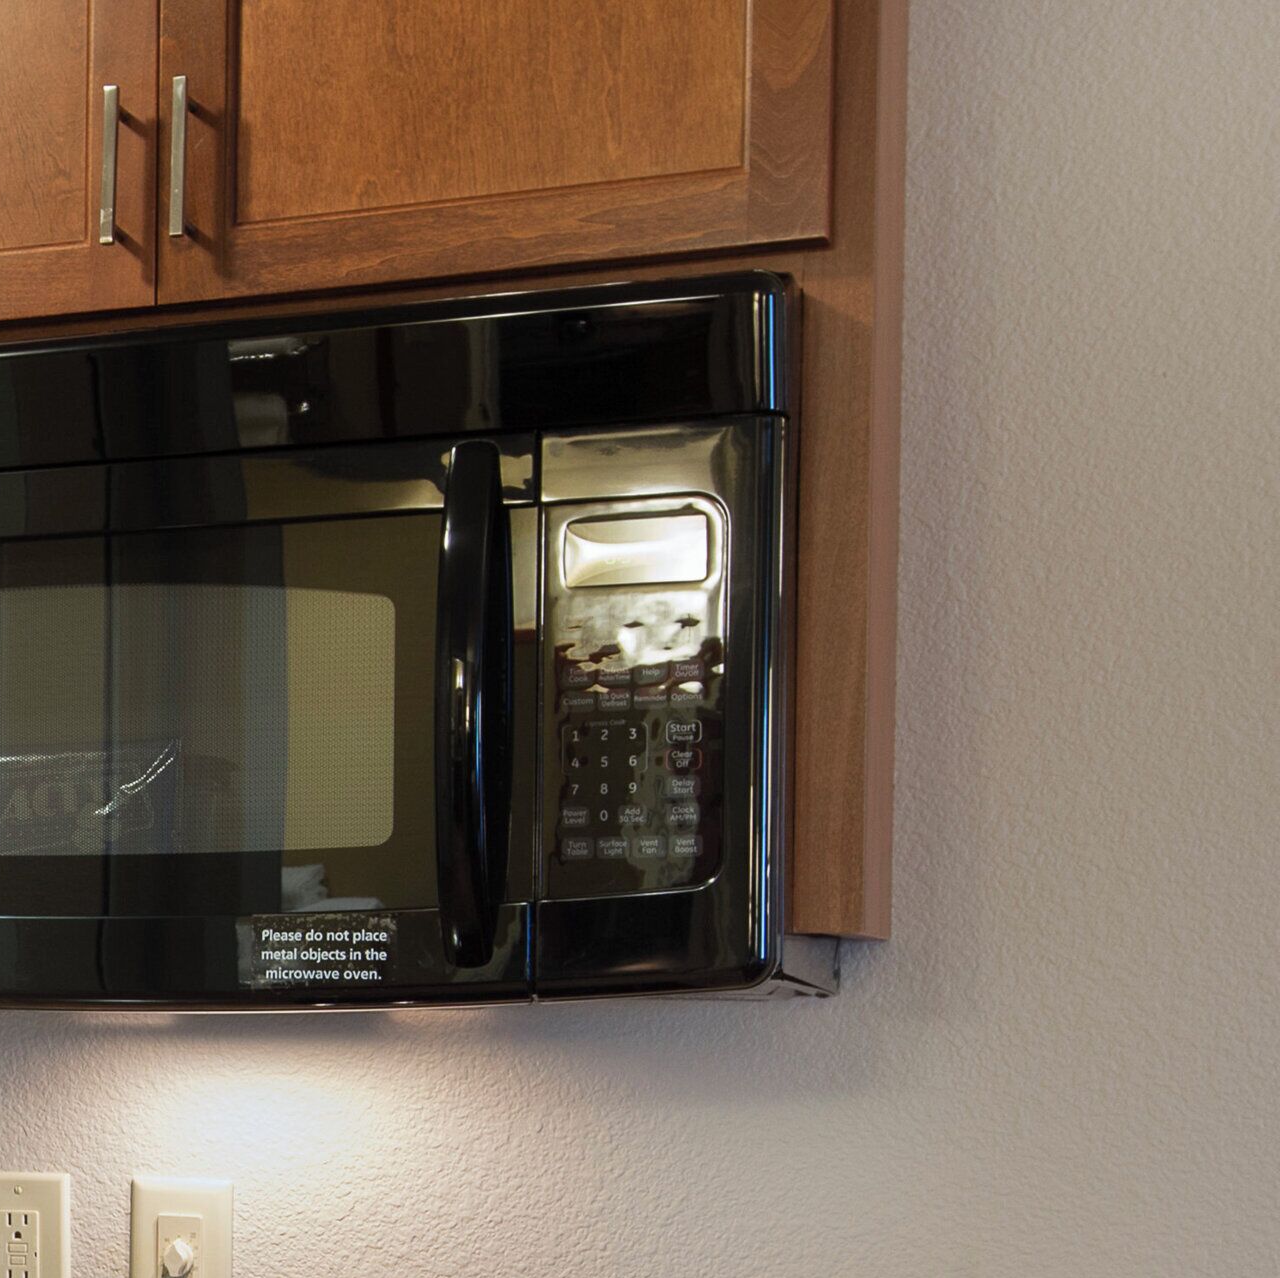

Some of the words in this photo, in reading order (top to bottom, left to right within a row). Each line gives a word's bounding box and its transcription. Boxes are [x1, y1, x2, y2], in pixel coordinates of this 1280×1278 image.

[676, 662, 699, 671] Timer
[642, 669, 661, 678] Help
[563, 697, 594, 706] Custom
[671, 692, 703, 702] Options
[670, 722, 697, 733] Start
[572, 729, 580, 742] 1
[600, 728, 609, 741] 2
[628, 727, 637, 740] 3
[671, 749, 693, 759] Clear
[571, 756, 580, 769] 4
[600, 755, 609, 768] 5
[628, 754, 637, 767] 6
[676, 758, 690, 768] Off
[628, 781, 637, 794] 9
[671, 778, 695, 788] Delay
[571, 783, 580, 796] 7
[600, 782, 609, 795] 8
[672, 785, 694, 795] Start
[624, 807, 641, 815] Add
[672, 806, 695, 814] Clock
[599, 809, 609, 822] 0
[599, 839, 628, 848] Surface
[640, 838, 659, 847] Vent
[676, 837, 695, 846] Vent
[642, 846, 657, 855] Fan
[261, 929, 302, 942] Please
[305, 929, 323, 942] do
[326, 931, 350, 942] not
[353, 929, 388, 945] place
[261, 948, 297, 961] metal
[300, 948, 347, 963] objects
[350, 948, 362, 961] in
[365, 948, 388, 961] the
[265, 968, 340, 980] microwave
[343, 970, 382, 980] oven.
